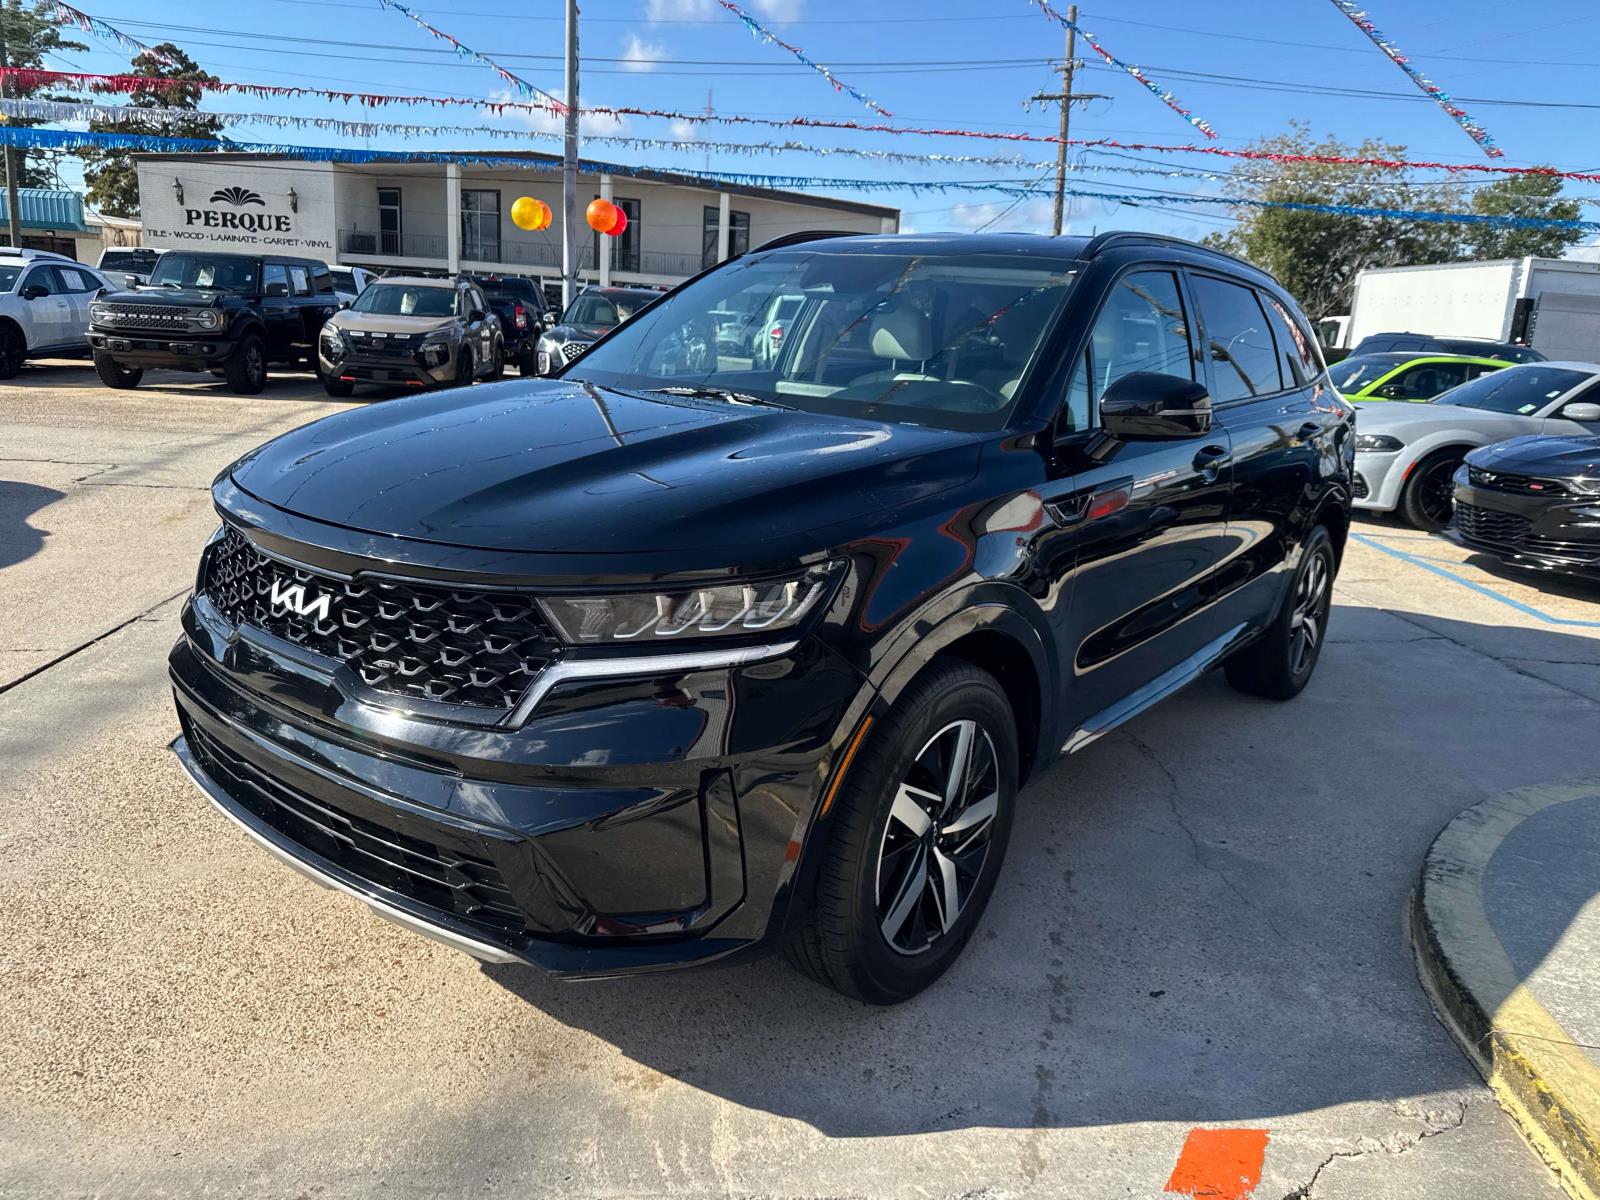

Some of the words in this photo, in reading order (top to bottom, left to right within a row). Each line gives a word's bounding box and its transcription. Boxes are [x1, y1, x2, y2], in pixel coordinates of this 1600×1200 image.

[185, 208, 292, 233] PERQUE
[147, 229, 167, 238] TILE
[174, 231, 205, 240] WOOD
[210, 233, 258, 244] LAMINATE
[263, 237, 300, 247] CARPET
[305, 240, 332, 249] VINYL
[271, 577, 331, 622] KIA
